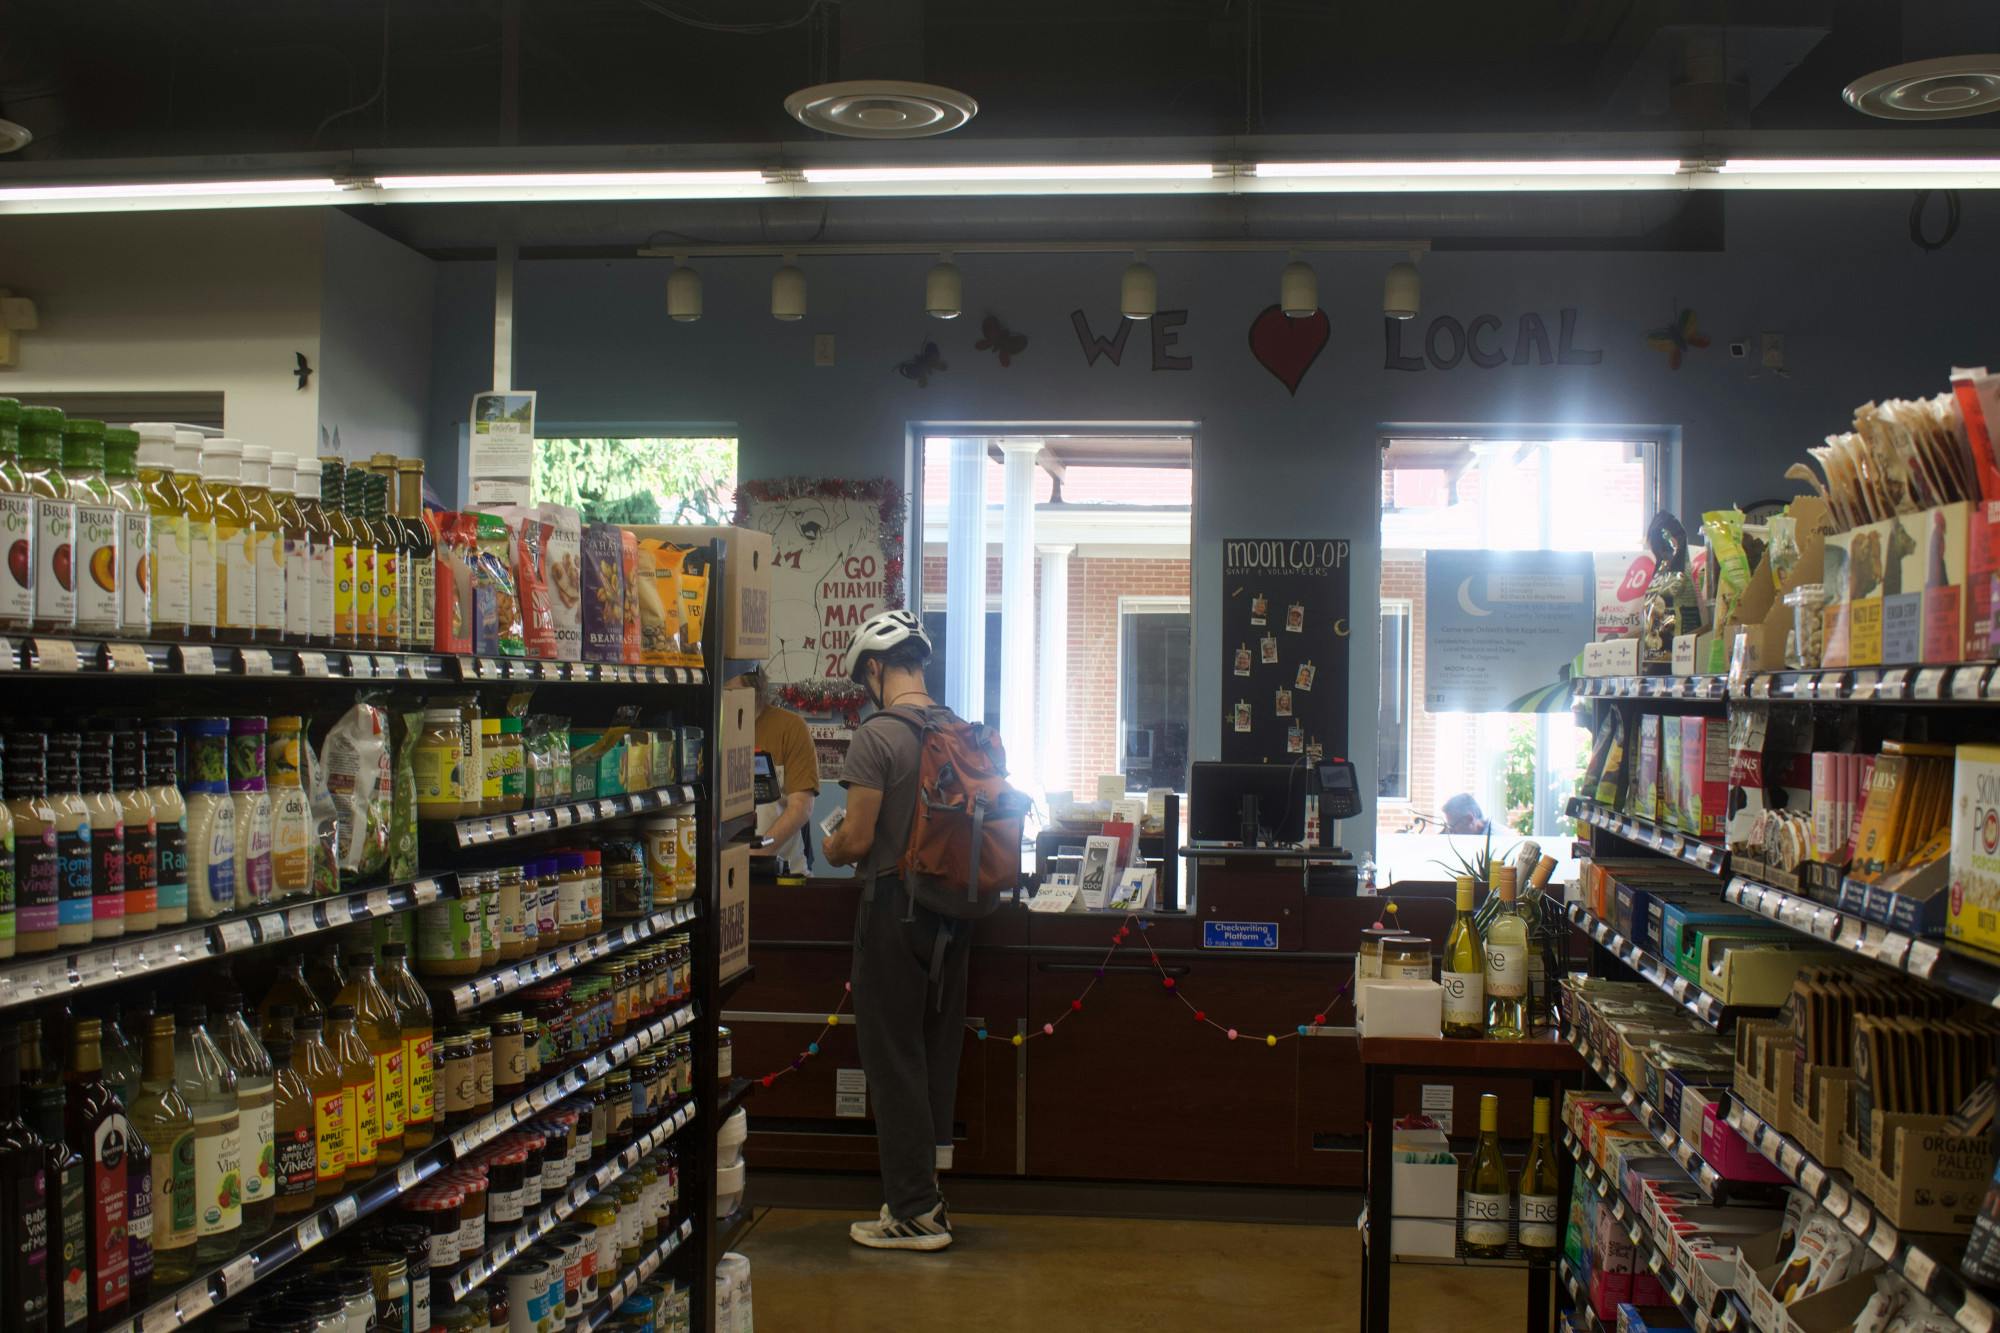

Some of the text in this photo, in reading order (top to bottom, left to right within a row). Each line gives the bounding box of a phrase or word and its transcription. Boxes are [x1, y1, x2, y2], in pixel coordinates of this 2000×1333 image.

[1071, 308, 1604, 373] WE LOCAL
[844, 555, 876, 579] GO
[824, 603, 875, 627] MAC
[553, 630, 580, 641] COCON
[590, 633, 615, 643] BEAN
[821, 630, 850, 650] CHA
[825, 653, 848, 678] 20
[1976, 769, 2000, 806] SKIN
[1973, 805, 2000, 856] PO
[1215, 923, 1268, 933] Checkwriting
[1224, 932, 1259, 940] Platform
[1487, 951, 1505, 972] Re
[385, 1089, 403, 1103] APPL
[360, 1118, 376, 1132] APPL
[320, 1129, 341, 1144] APPLE
